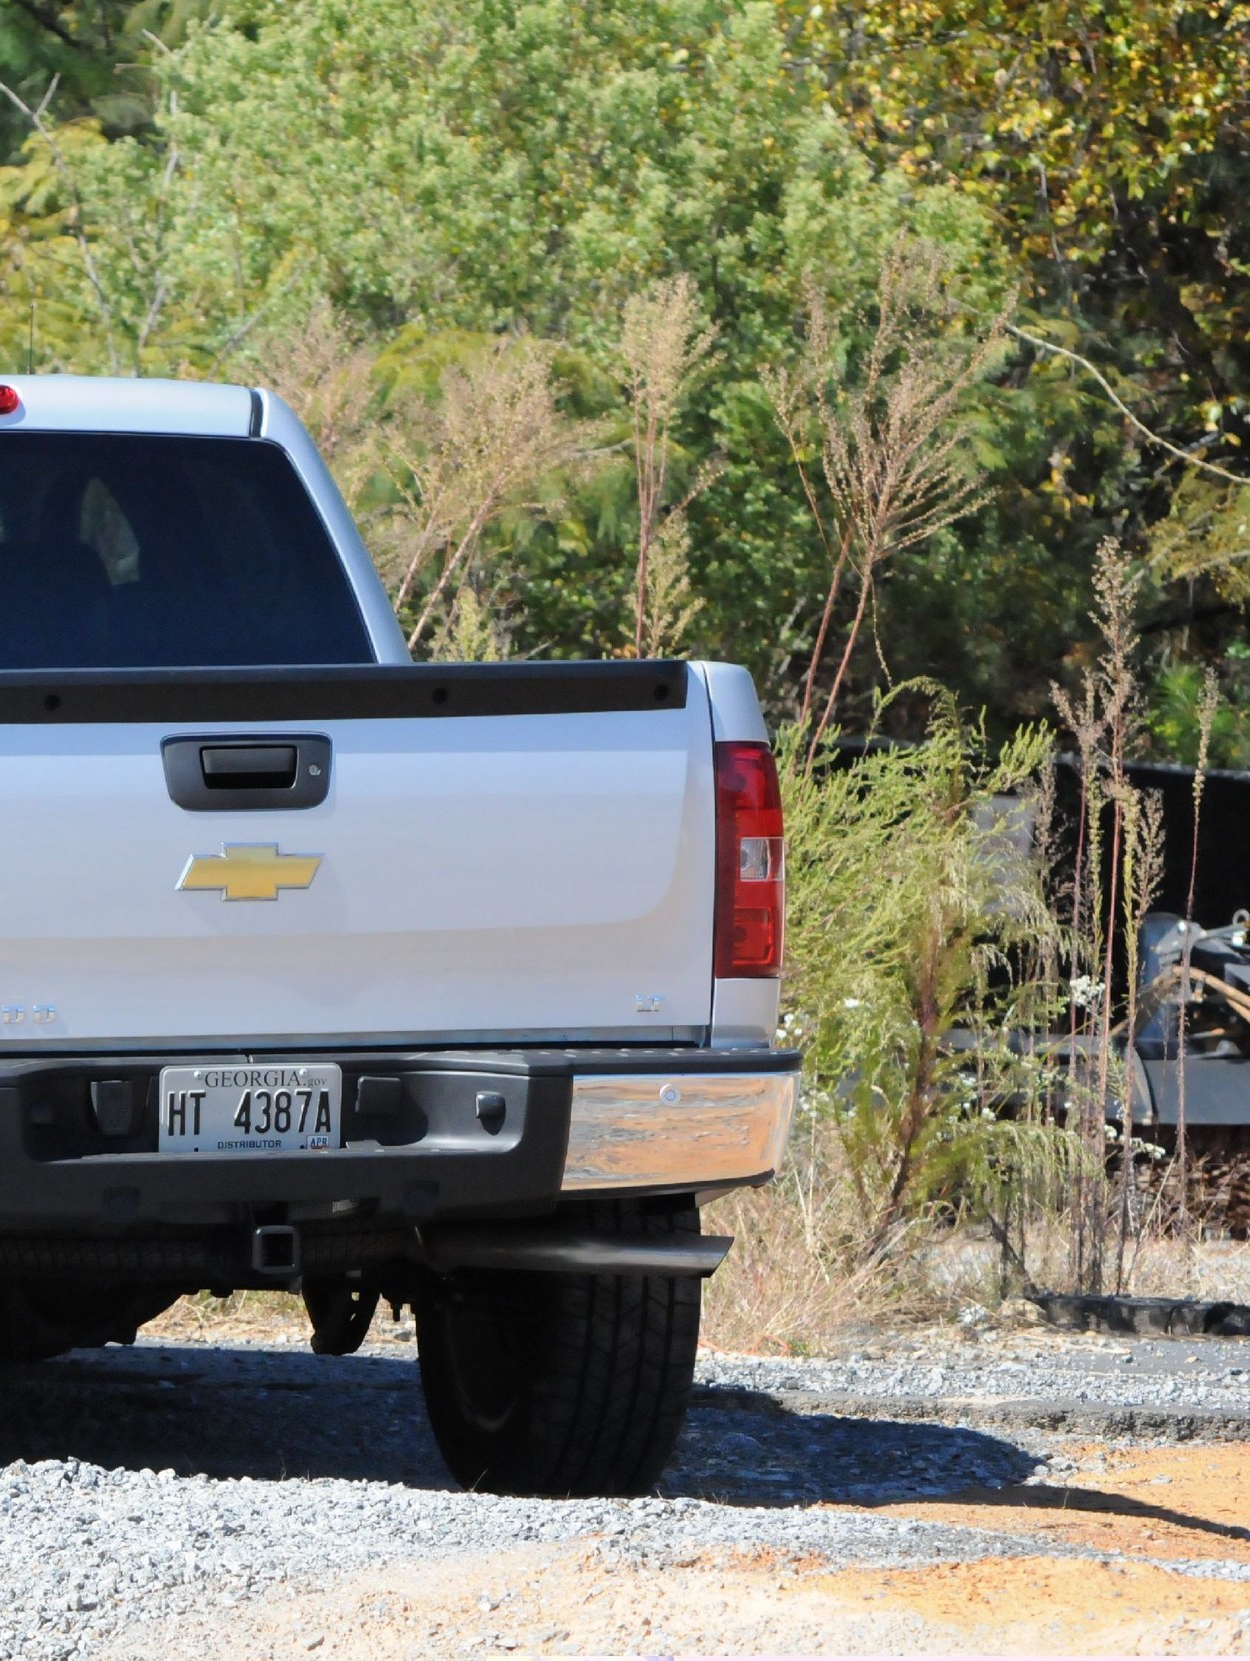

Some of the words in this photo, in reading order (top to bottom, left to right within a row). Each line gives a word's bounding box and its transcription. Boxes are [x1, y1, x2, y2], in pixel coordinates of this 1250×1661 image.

[167, 1089, 207, 1136] HT
[233, 1088, 332, 1135] 4387A
[217, 1139, 282, 1150] DISTRIBUTOR
[310, 1137, 328, 1148] APR
